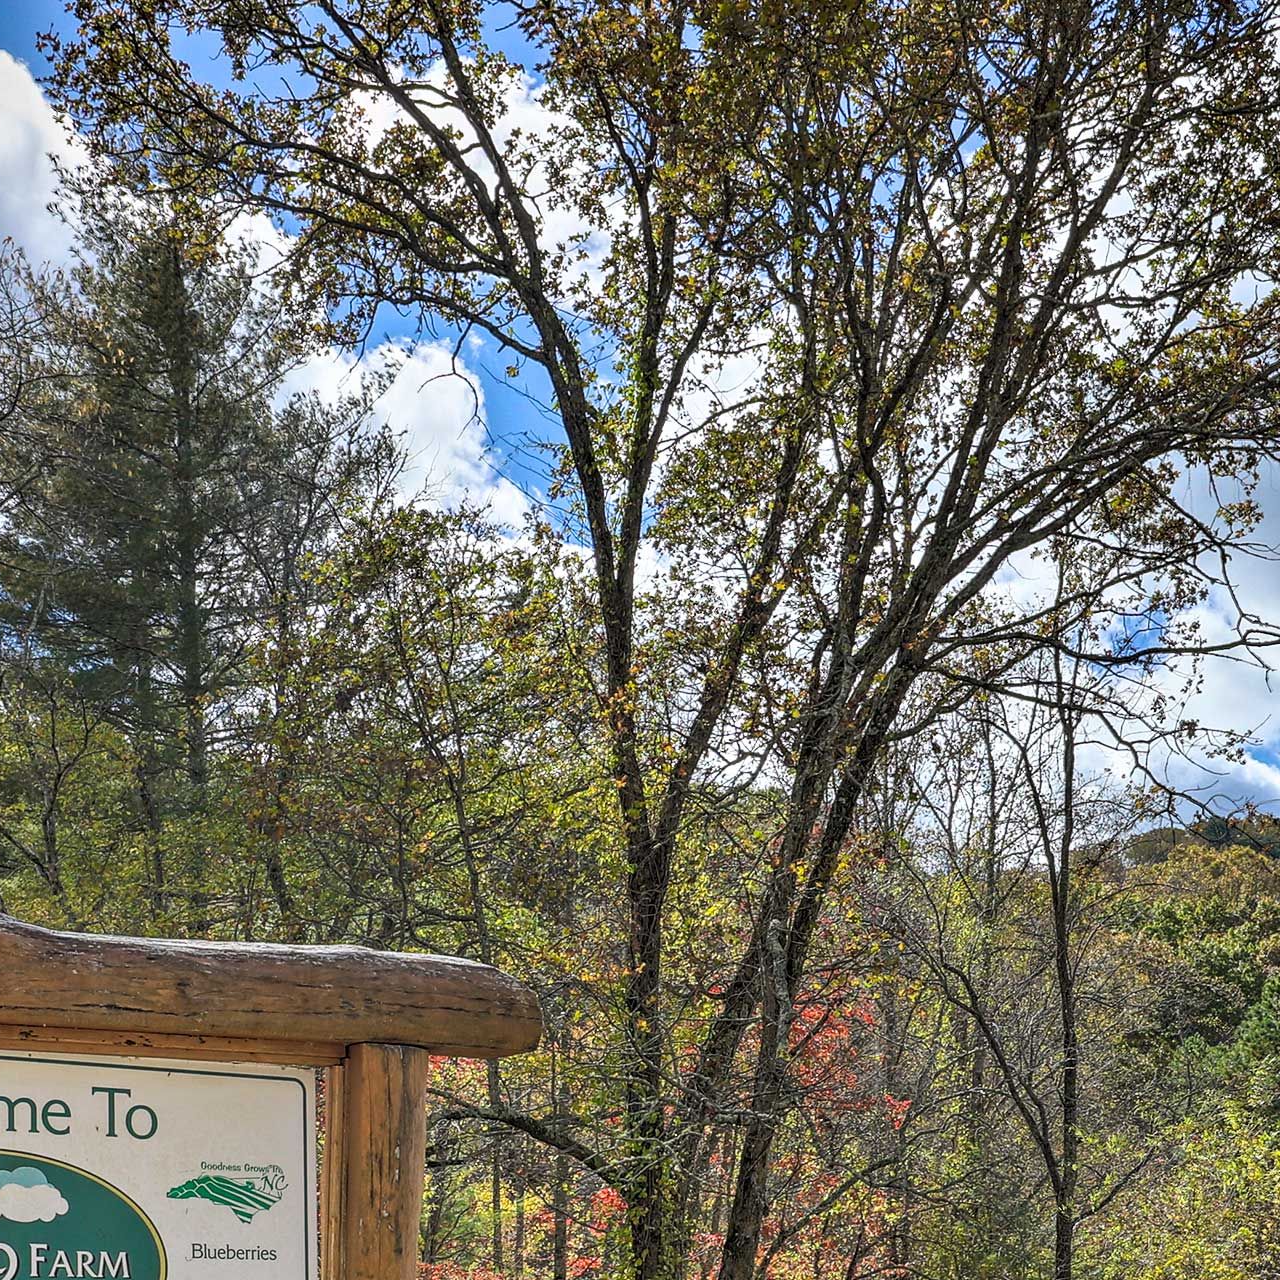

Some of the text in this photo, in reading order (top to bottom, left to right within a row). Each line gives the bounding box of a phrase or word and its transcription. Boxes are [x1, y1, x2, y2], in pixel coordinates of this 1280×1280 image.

[92, 1087, 158, 1140] To
[201, 1161, 241, 1171] Goodness
[260, 1174, 288, 1191] NC
[29, 1243, 131, 1279] FARM
[191, 1244, 277, 1261] Blueberries
